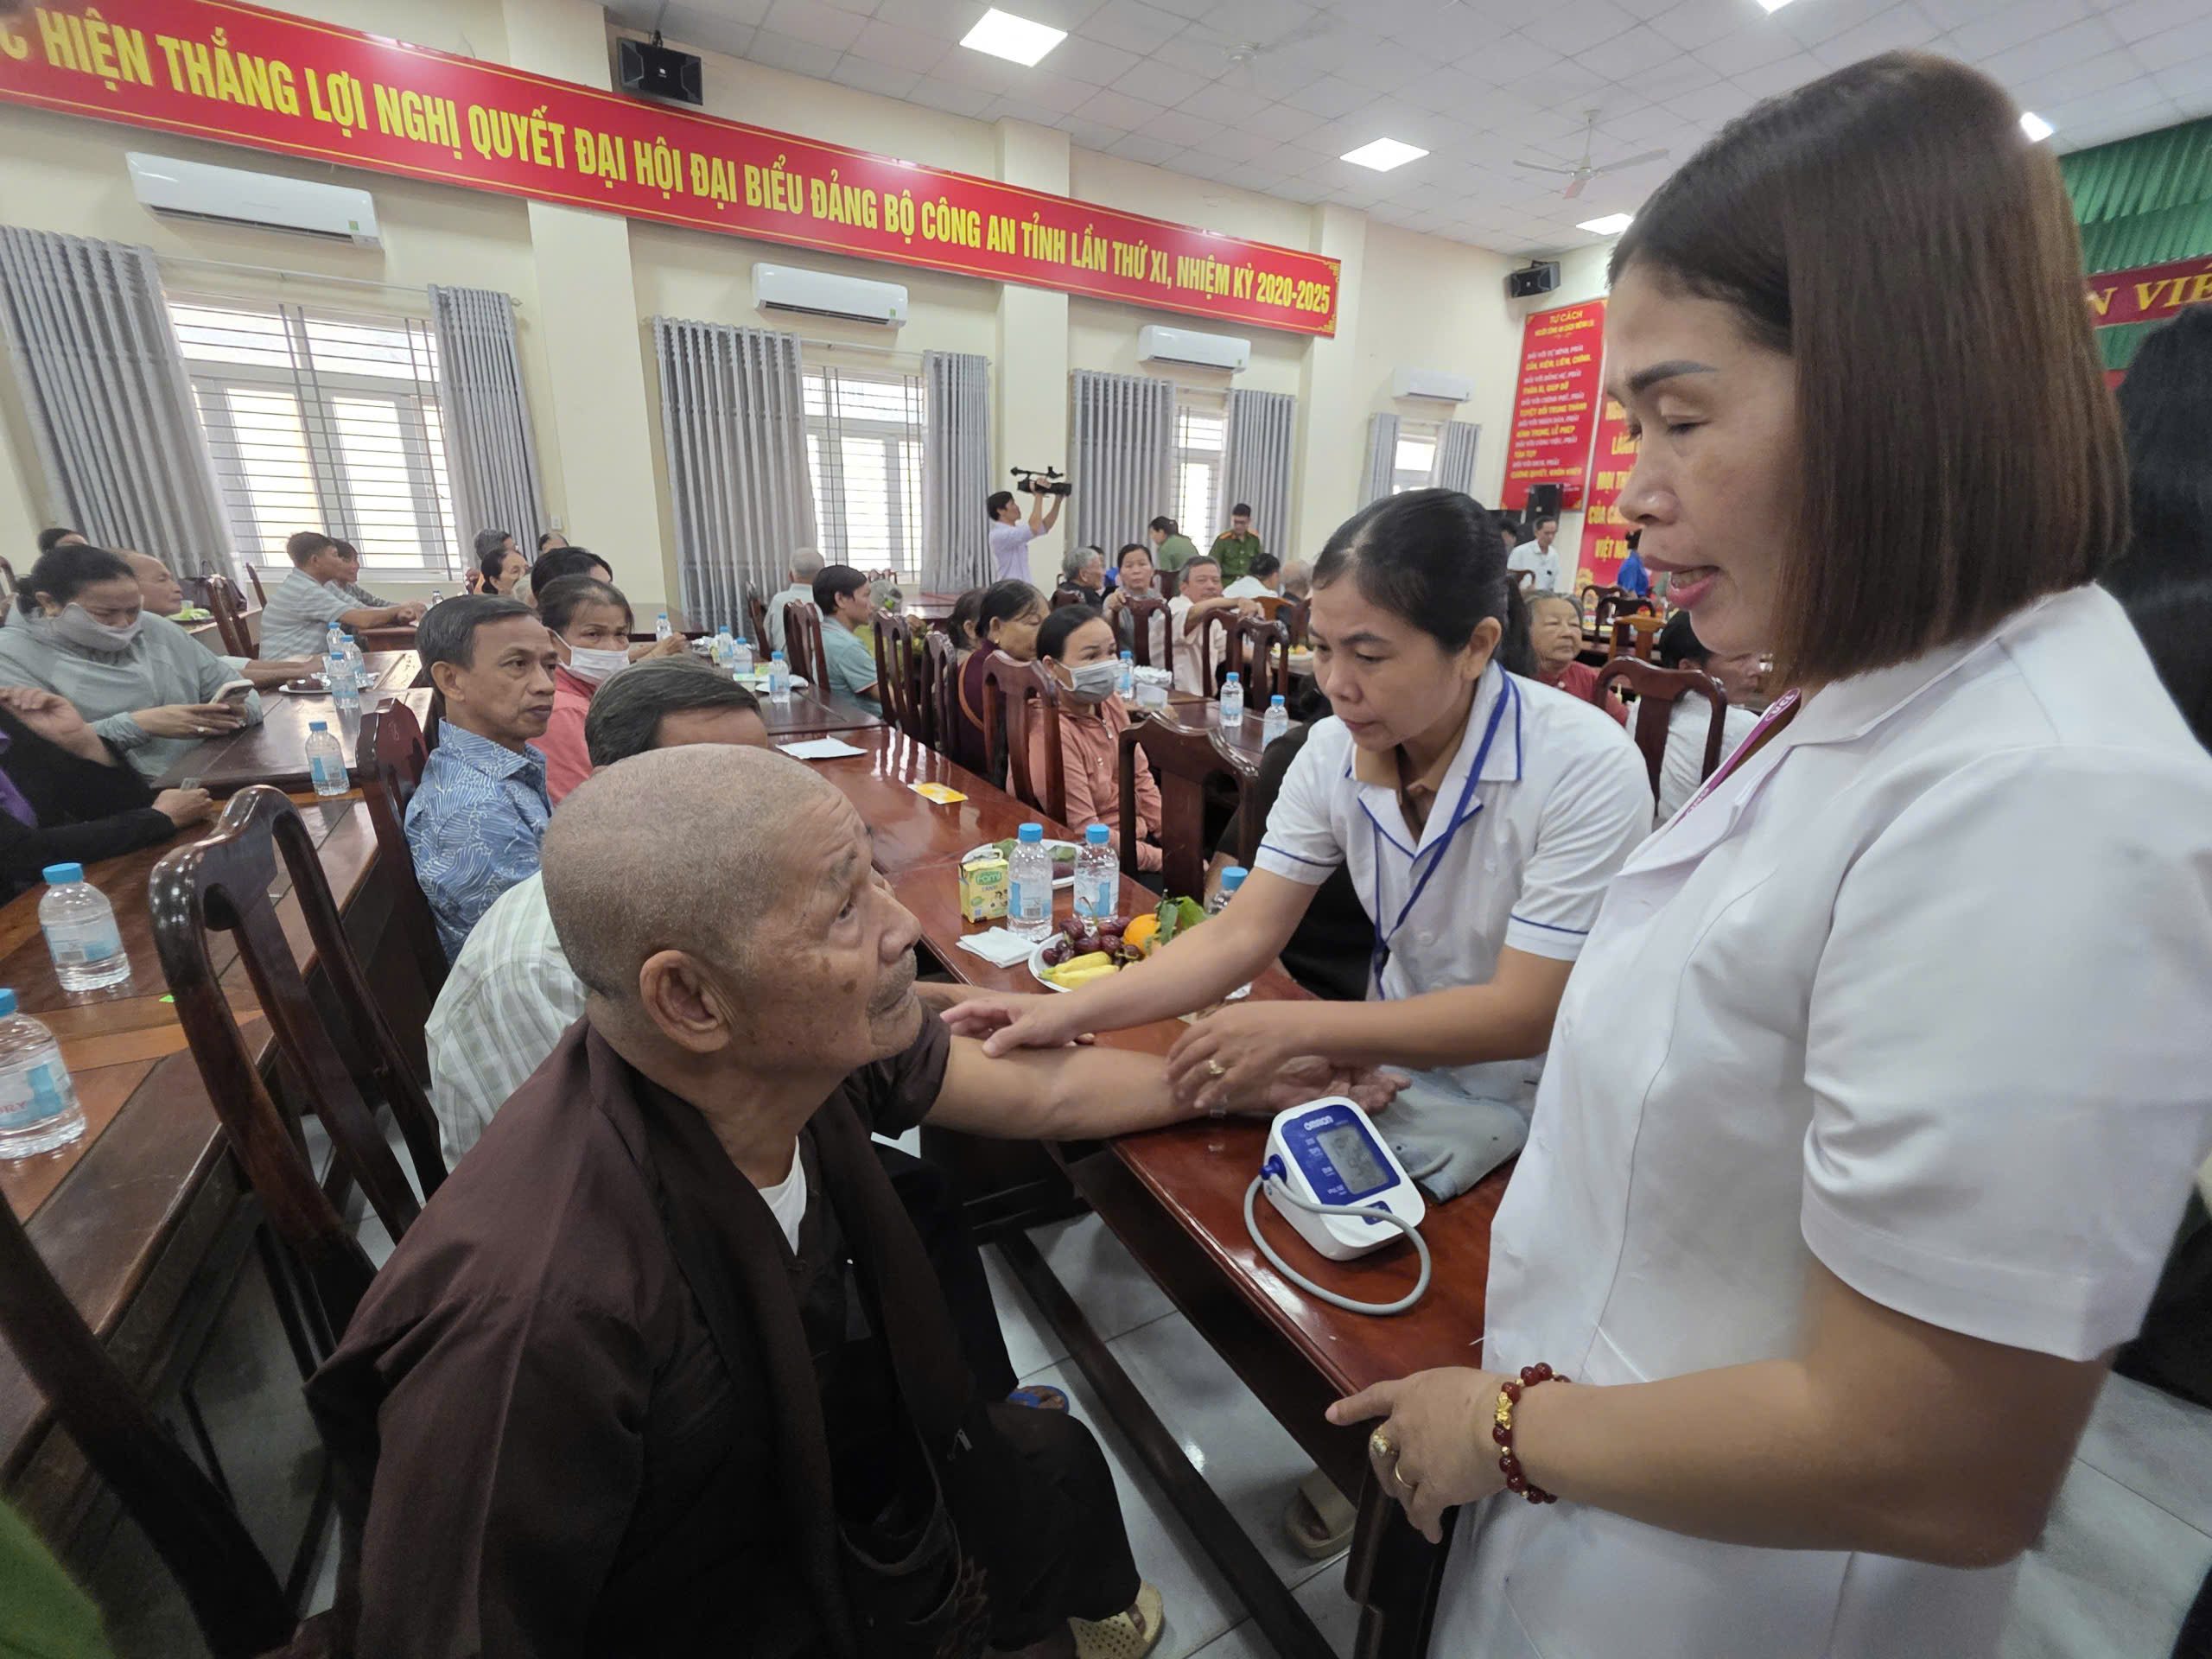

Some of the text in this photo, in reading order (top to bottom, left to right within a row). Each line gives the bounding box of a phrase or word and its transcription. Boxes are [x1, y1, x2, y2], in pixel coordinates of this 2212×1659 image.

[35, 6, 154, 92] HIỆN
[156, 27, 301, 118] THẮNG
[304, 67, 367, 138] LỢI
[373, 83, 461, 161] NGHỊ
[468, 105, 565, 169] QUYẾT
[574, 127, 627, 189] ĐẠI
[633, 135, 683, 200] HỘI
[690, 152, 738, 210] ĐẠI
[744, 154, 804, 215] BIỂU
[810, 168, 878, 230] ĐẢNG
[883, 188, 915, 245] BỘ
[921, 196, 982, 249] CÔNG
[986, 215, 1016, 255] AN
[1020, 212, 1066, 264] TỈNH
[1071, 223, 1108, 273] LẦN
[1112, 239, 1148, 281] THỨ
[1149, 249, 1173, 289] XI,
[1176, 254, 1230, 300] NHIỆM
[1233, 262, 1255, 300] KỲ
[1255, 271, 1332, 315] 2020-2025
